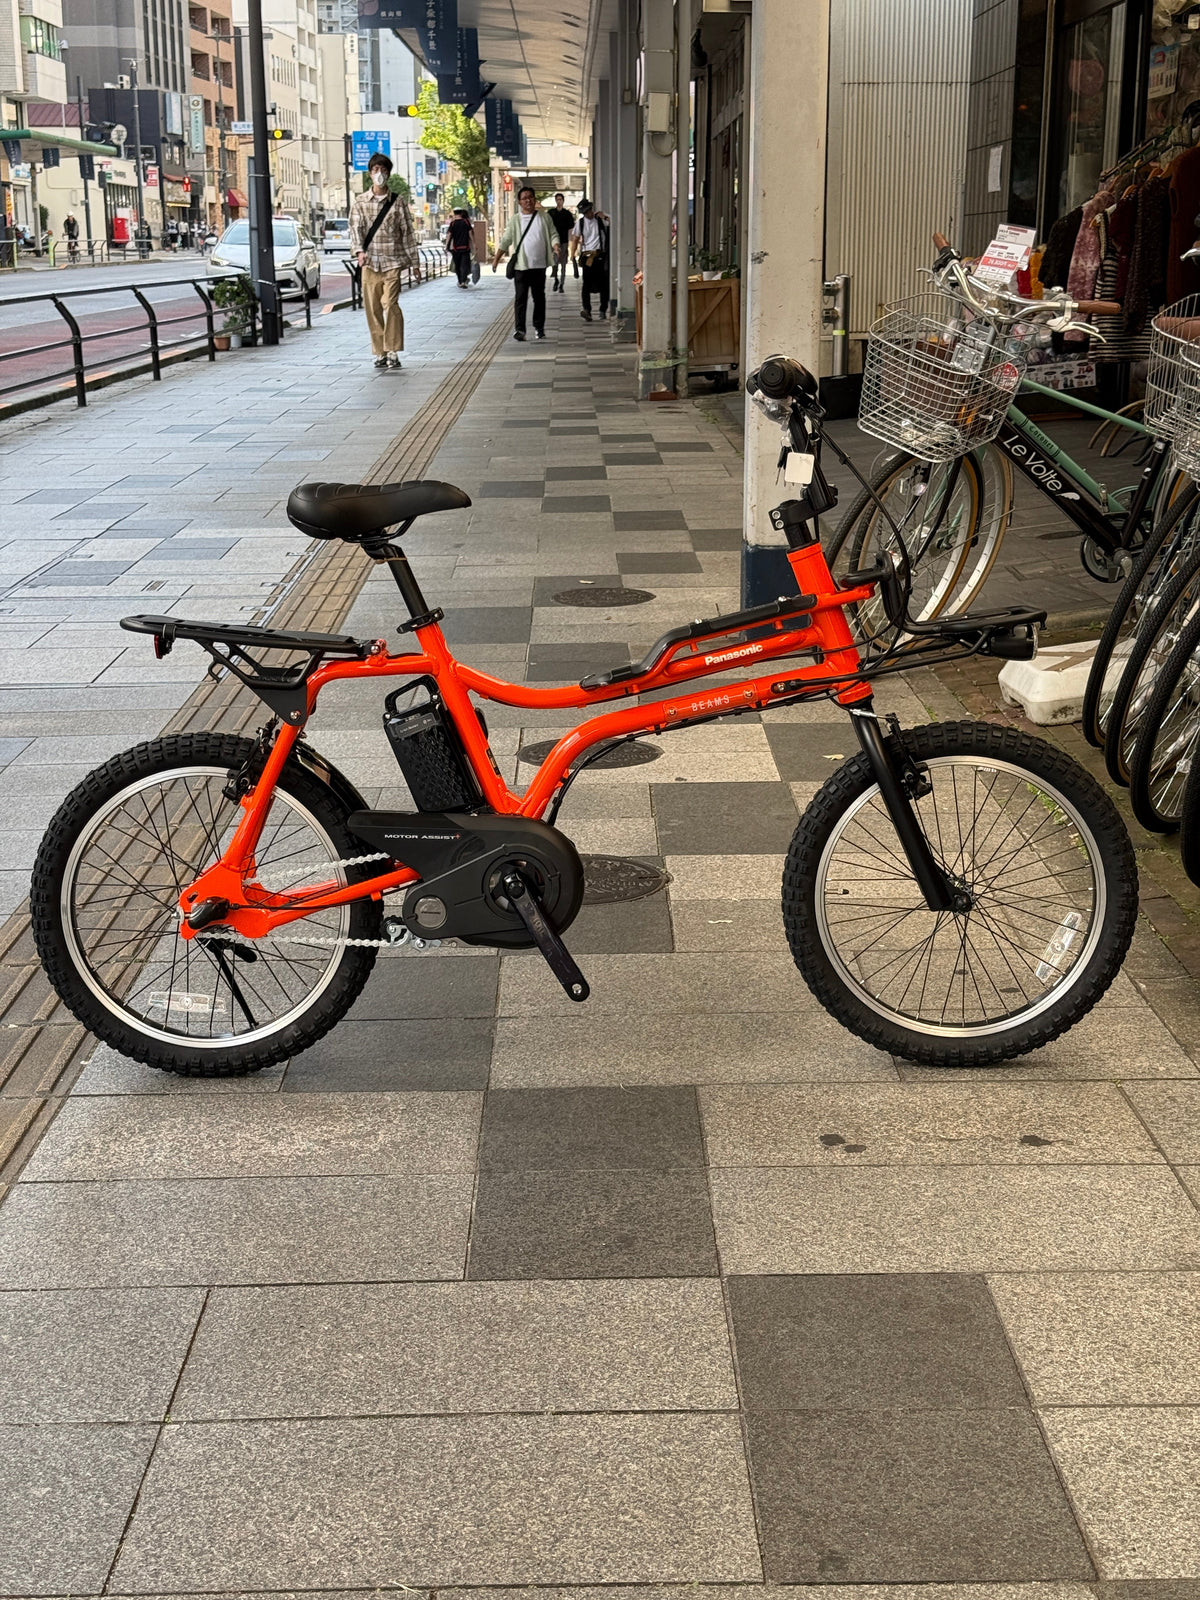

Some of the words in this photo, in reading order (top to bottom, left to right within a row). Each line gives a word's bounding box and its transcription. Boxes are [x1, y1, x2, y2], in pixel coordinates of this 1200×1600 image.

[1002, 434, 1027, 457] Le
[1024, 451, 1062, 491] Volte
[704, 644, 764, 666] Panasonic
[691, 695, 730, 712] BEAMS
